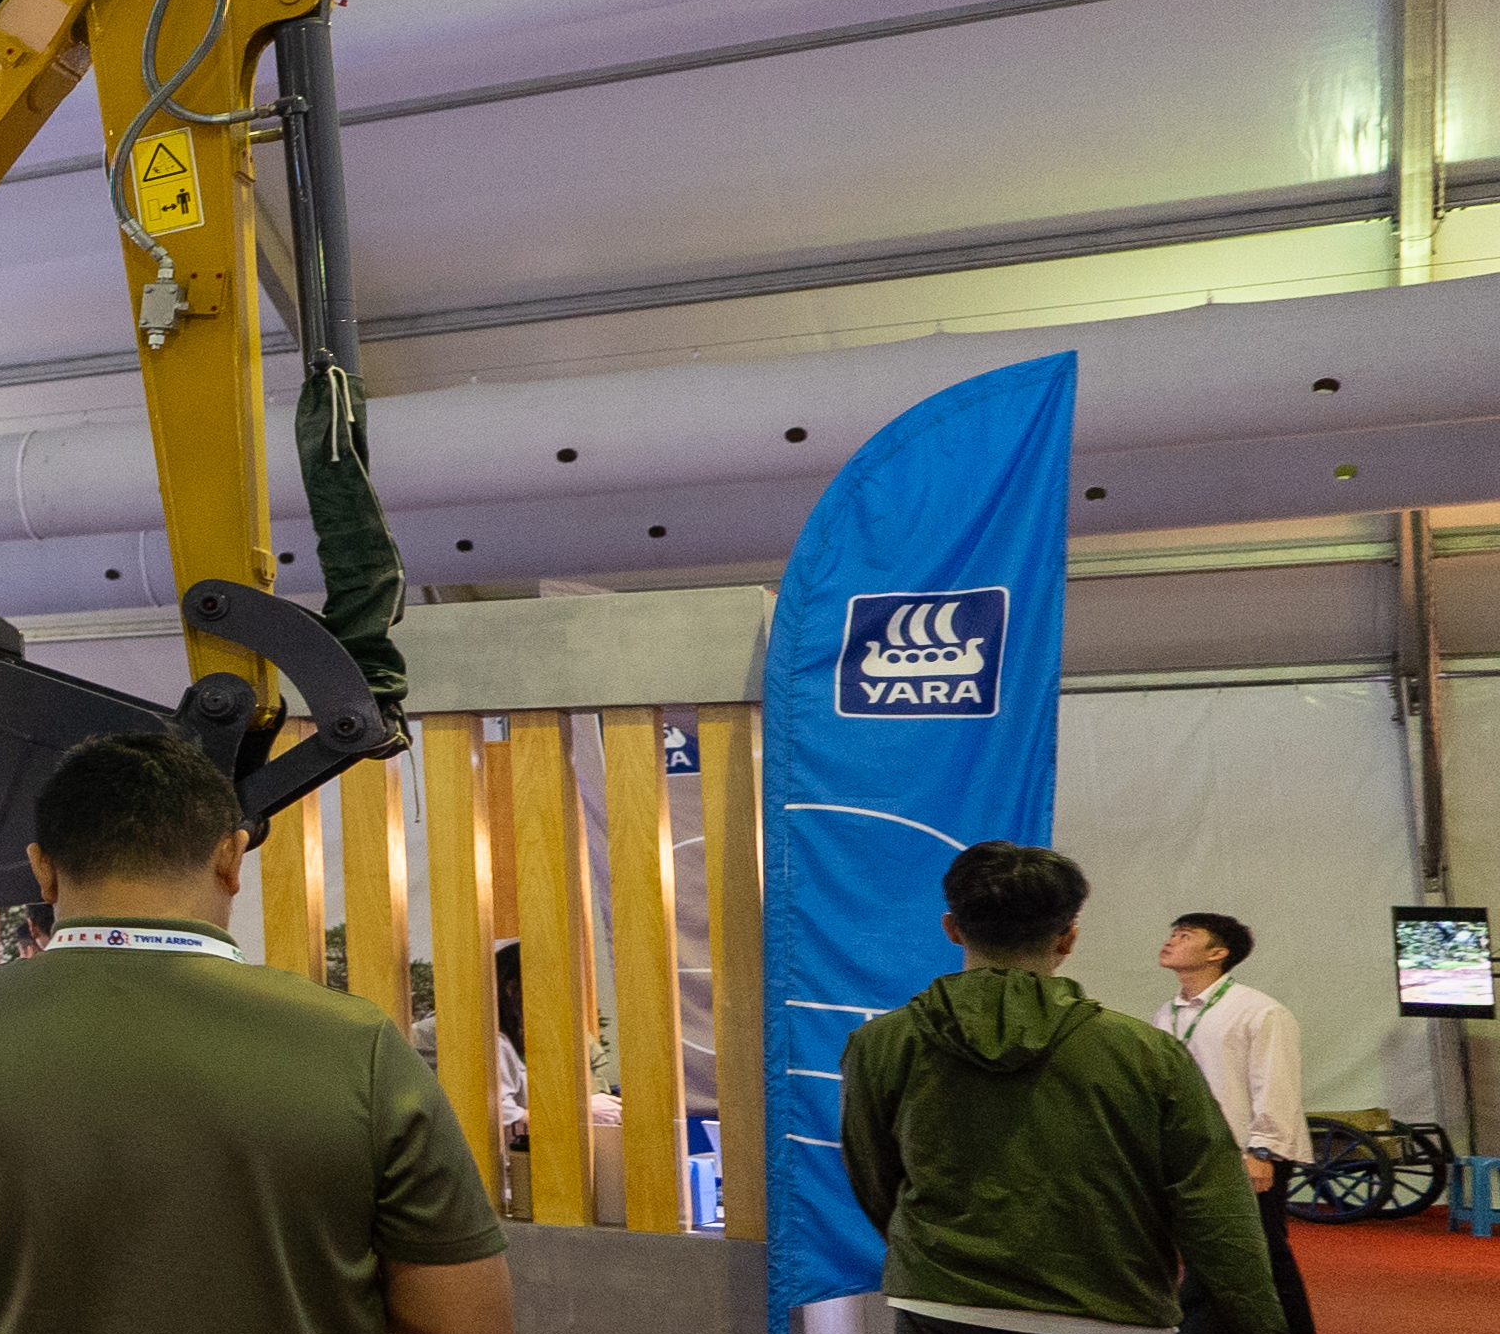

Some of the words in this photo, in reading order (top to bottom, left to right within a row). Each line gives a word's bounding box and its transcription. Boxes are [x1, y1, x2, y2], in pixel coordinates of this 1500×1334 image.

[860, 680, 981, 704] YARA
[133, 934, 162, 944] TWIN
[165, 935, 203, 947] ARROW
